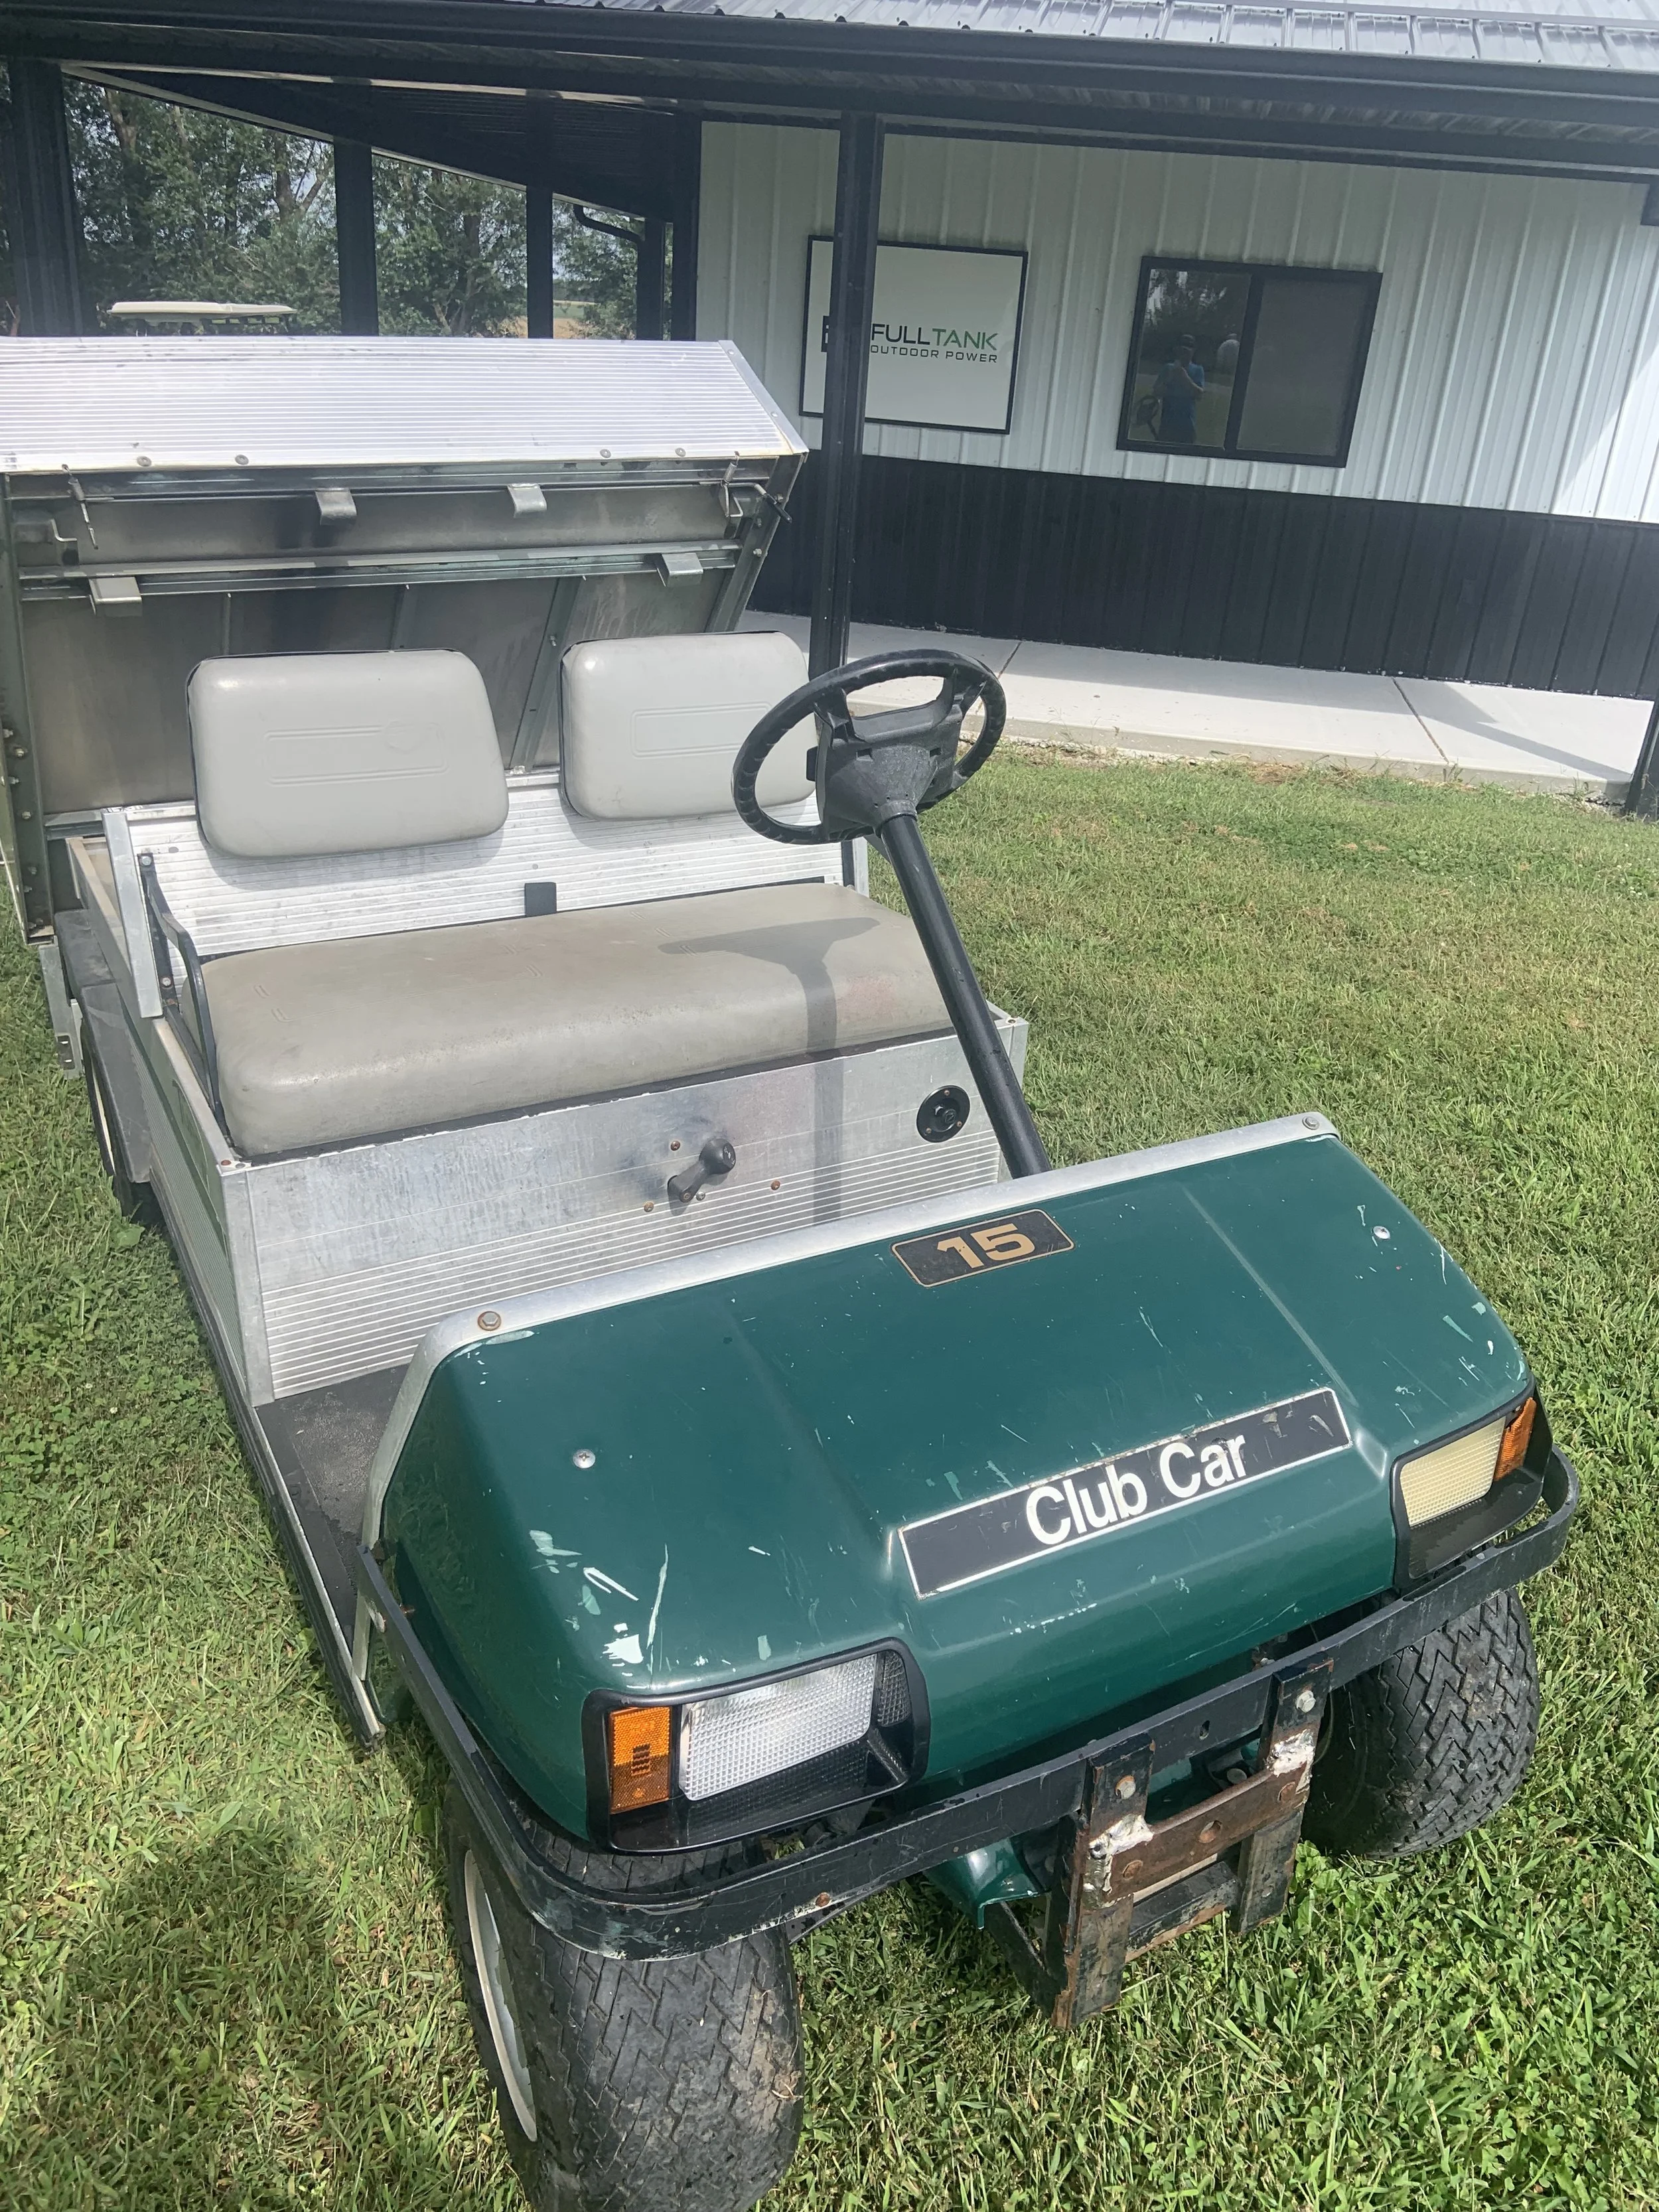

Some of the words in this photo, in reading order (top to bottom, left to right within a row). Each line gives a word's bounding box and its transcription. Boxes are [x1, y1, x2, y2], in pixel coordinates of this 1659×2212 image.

[871, 344, 939, 358] OUTDOOR
[946, 351, 997, 363] POWER
[937, 1223, 1035, 1268] 15
[1026, 1465, 1148, 1545] Club
[1159, 1434, 1248, 1498] Car
